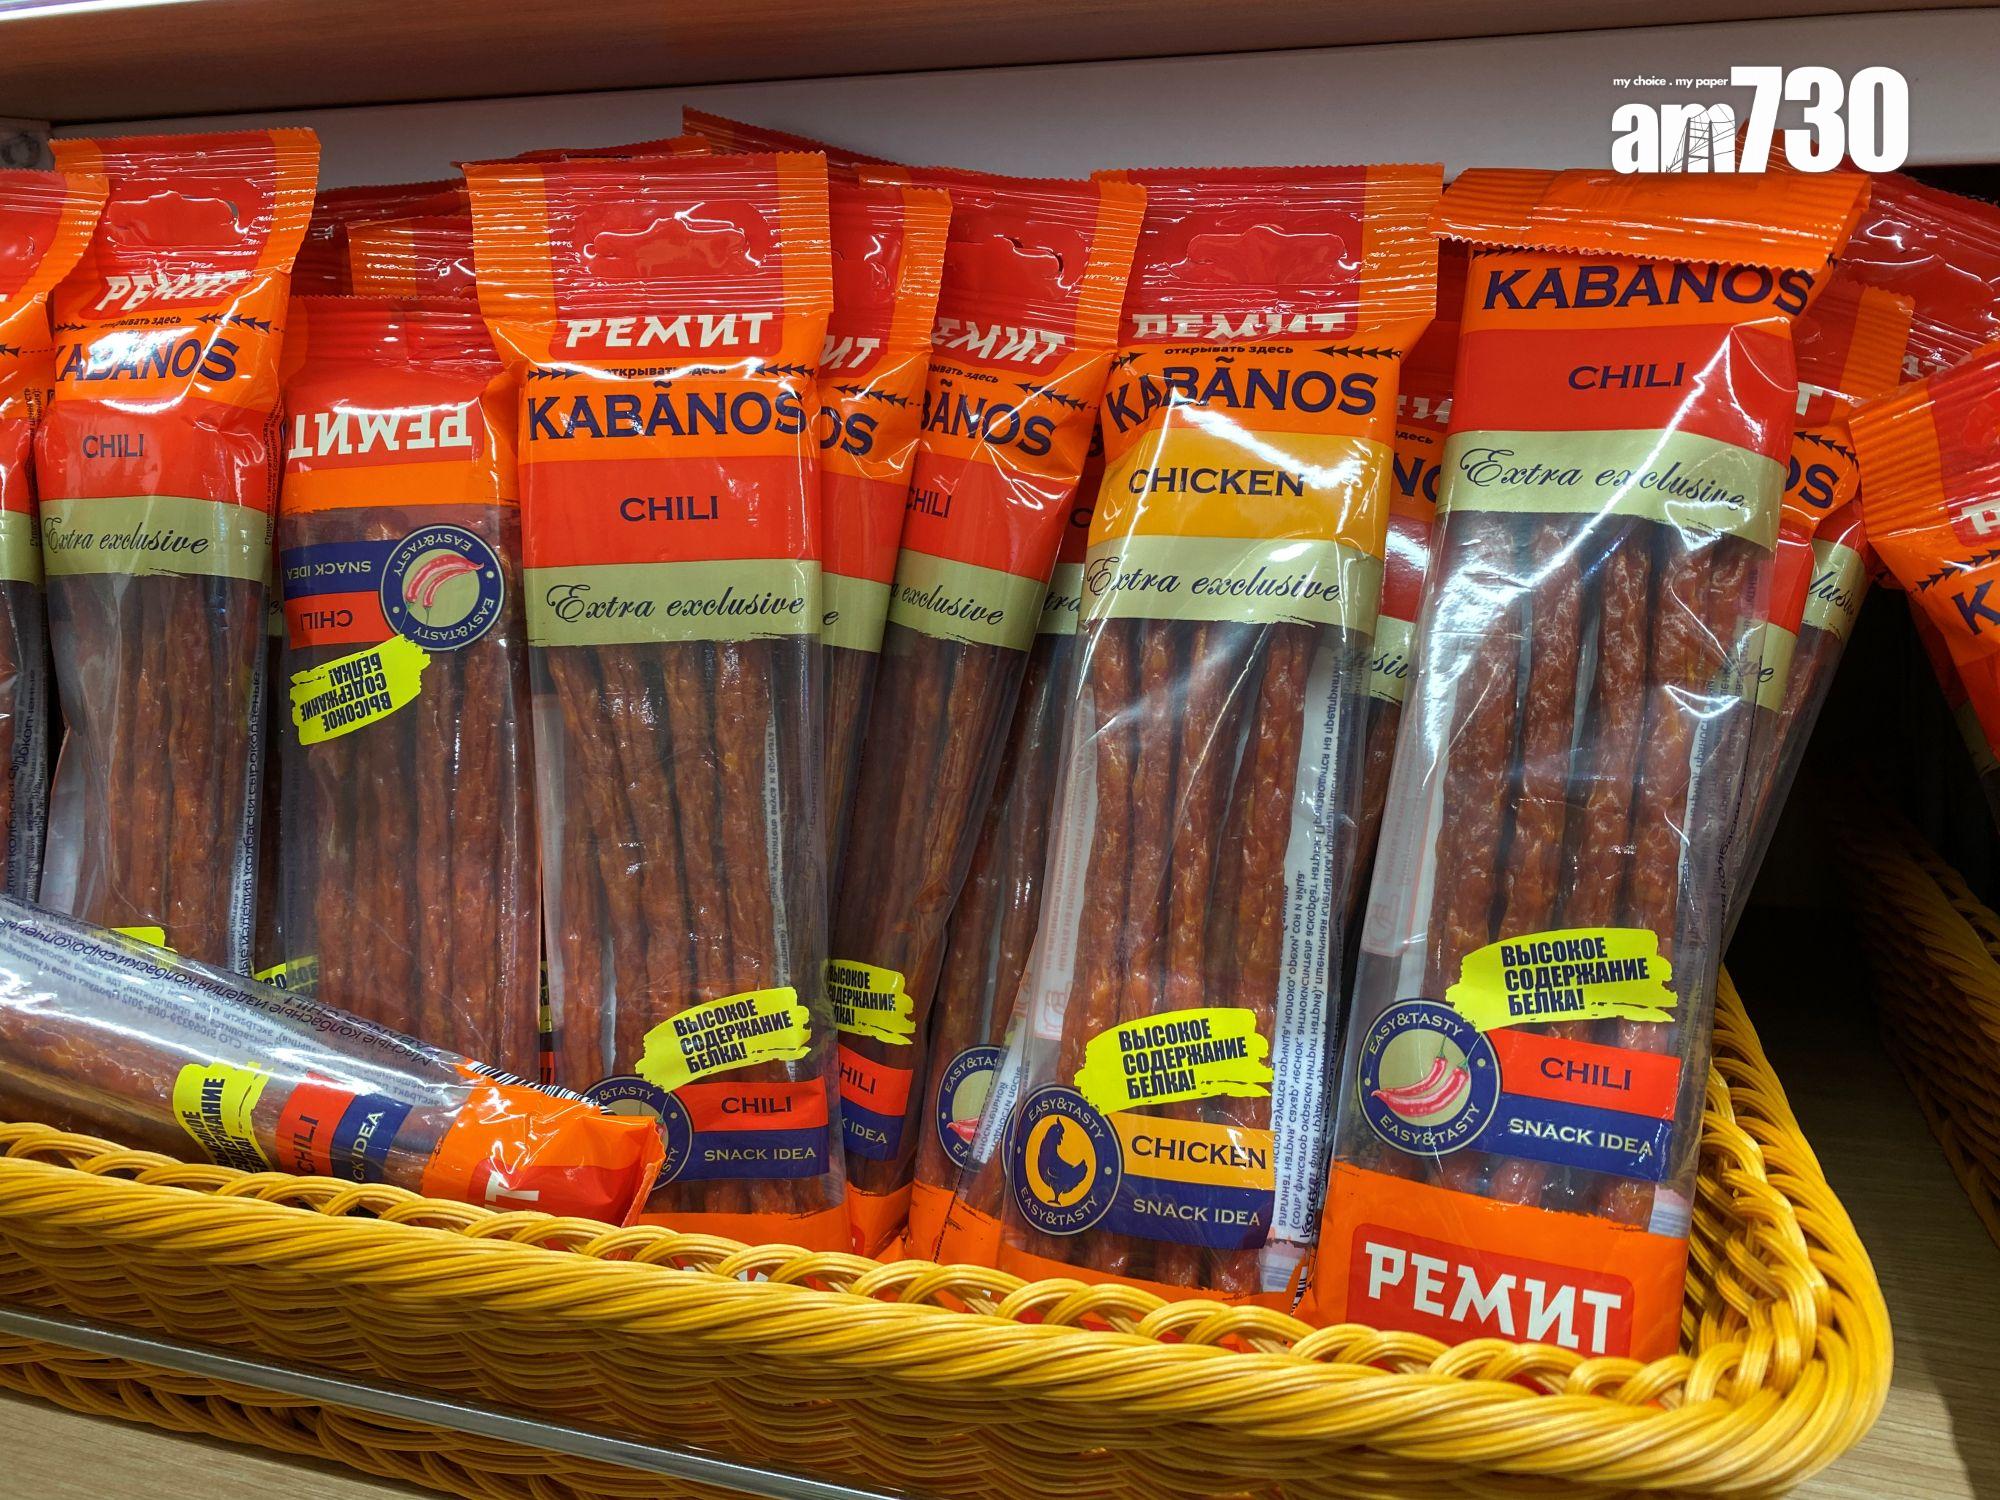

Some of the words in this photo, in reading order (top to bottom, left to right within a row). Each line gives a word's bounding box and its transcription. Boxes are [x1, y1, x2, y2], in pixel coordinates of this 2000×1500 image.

[151, 315, 182, 325] здесь
[565, 312, 773, 348] РЕМИТ
[931, 317, 1068, 367] ЕМИТ
[1164, 346, 1245, 355] открывать
[1248, 346, 1293, 354] здесь
[965, 372, 998, 384] здесь
[1568, 362, 1686, 389] CHILI
[527, 380, 807, 440] KABÃNOS
[82, 434, 144, 458] CHILI
[288, 402, 472, 459] РЕМИТ
[1129, 467, 1304, 496] CHICKEN
[1460, 448, 1583, 487] Extra
[1595, 462, 1746, 511] exclusive
[620, 495, 718, 521] CHILI
[45, 517, 94, 554] Extra
[99, 522, 209, 554] exclusive
[315, 560, 371, 575] SNACK
[394, 531, 472, 577] EASY&TASTY
[287, 564, 313, 580] IDEA
[1087, 556, 1180, 597] Extra
[1192, 566, 1340, 602] exclusive
[299, 608, 353, 631] CHILI
[414, 597, 494, 641] EASY&TASTY
[547, 584, 655, 622] Extra
[666, 586, 805, 619] exclusive
[902, 584, 1004, 625] exclusive
[329, 652, 382, 687] БЕЛКА!
[302, 672, 387, 722] СОДЕРЖАНИЕ
[324, 691, 392, 732] ВЫСОКОЕ
[1501, 937, 1607, 968] ВЫСОКОЕ
[1504, 957, 1650, 992] СОДЕРЖАНИЕ
[673, 998, 759, 1037] ВЫСОКОЕ
[1509, 989, 1586, 1016] БЕЛКА!
[680, 1010, 793, 1055] СОДЕРЖАНИЕ
[1118, 1018, 1212, 1052] ВЫСОКОЕ
[1369, 1012, 1464, 1056] EASY&TASTY
[686, 1042, 747, 1074] БЕЛКА!
[1123, 1037, 1248, 1075] СОДЕРЖАНИЕ
[840, 1062, 876, 1095] HILI
[1127, 1069, 1196, 1099] БЕЛКА!
[1540, 1057, 1632, 1091] CHILI
[720, 1096, 793, 1114] CHILI
[1028, 1097, 1105, 1140] EASY&TASTY
[351, 1111, 386, 1159] IDEA
[851, 1122, 888, 1144] IDEA
[1380, 1102, 1480, 1147] EASY&TASTY
[1509, 1118, 1593, 1145] SNACK
[1600, 1132, 1653, 1157] IDEA
[294, 1114, 319, 1174] CHILI
[703, 1149, 766, 1162] SNACK
[773, 1147, 816, 1160] IDEA
[1131, 1135, 1267, 1170] CHICKEN
[1021, 1186, 1099, 1226] EASY&TASTY
[1133, 1198, 1209, 1222] SNACK
[1215, 1208, 1260, 1226] IDEA
[1365, 1240, 1623, 1354] РЕМИТ
